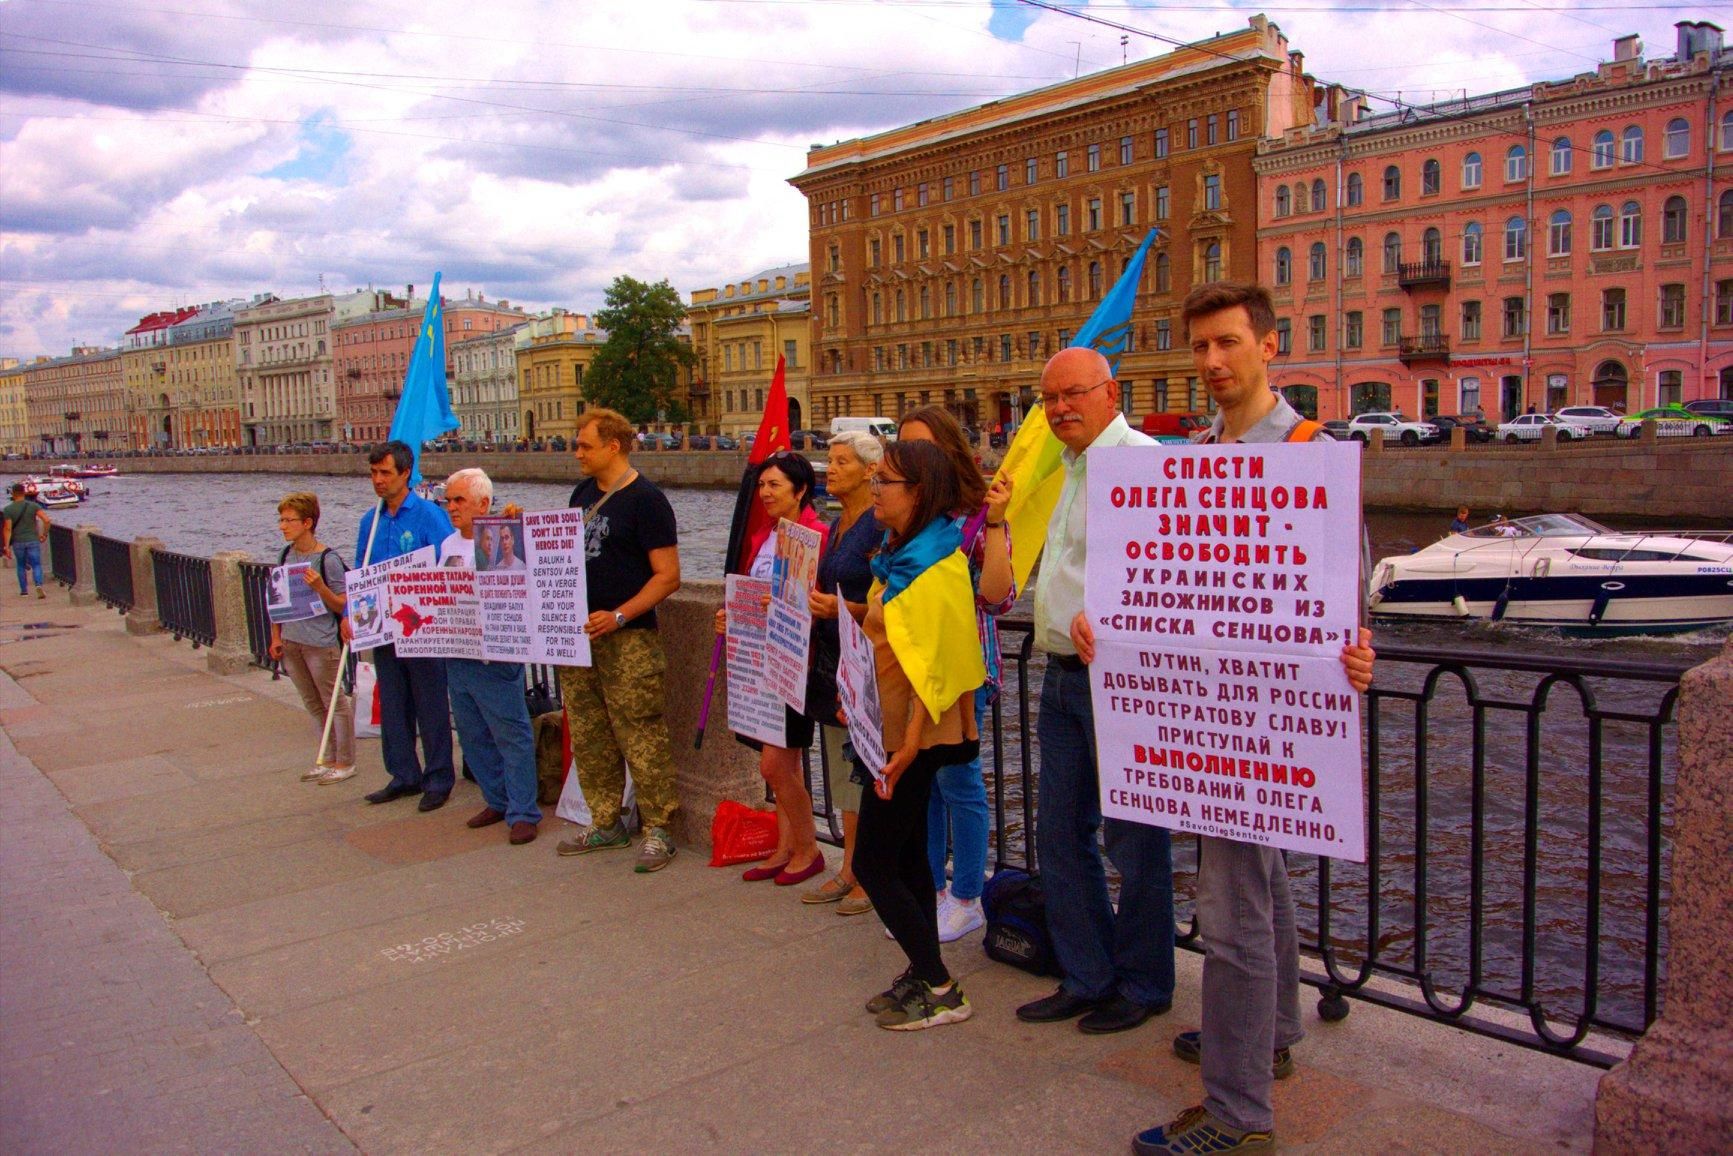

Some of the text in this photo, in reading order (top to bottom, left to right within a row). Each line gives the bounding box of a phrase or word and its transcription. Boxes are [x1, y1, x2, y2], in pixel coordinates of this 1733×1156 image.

[1163, 456, 1264, 480] СПАСТИ
[1110, 486, 1328, 511] ОЛЕГА СЕНЦОВА
[526, 516, 540, 526] SAVE
[542, 514, 560, 525] YOUR
[561, 512, 581, 523] SOUL!
[1158, 513, 1270, 538] ЗНАЧИТ
[531, 526, 577, 538] DON'T LET THE
[535, 539, 574, 551] HEROES DIE!
[538, 556, 565, 565] BALUKH
[1125, 541, 1307, 566] ОСВОБОДИТЬ
[360, 568, 370, 578] ЗА
[373, 562, 391, 574] ЭТОТ
[393, 554, 414, 567] ФЛАГ
[533, 567, 578, 577] SENTSOV ARE
[390, 571, 475, 583] КРЫМСКИЕ ТАТАРЫ
[536, 579, 577, 588] ON A VERGE
[1126, 567, 1308, 592] УКРАИНСКИХ
[394, 581, 474, 595] КОРЕННОЙ НАРОД
[541, 590, 573, 599] OF DEATH
[419, 596, 457, 606] КРЫМА!
[541, 601, 575, 610] AND YOUR
[1120, 589, 1325, 618] ЗАЛОЖНИКОВ ИЗ
[437, 608, 476, 616] ДЕКЛАРАЦИЯ
[541, 613, 576, 622] SILENCE IS
[432, 617, 448, 625] ООН
[455, 617, 476, 625] ПРАВАХ
[1099, 613, 1195, 636] «СПИСКА
[422, 626, 483, 636] КОРЕННЫХ НАРОДОВ
[537, 624, 582, 635] RESPONSIBLE
[397, 637, 445, 645] ГАРАНТИРУЕТ
[545, 636, 575, 646] FOR THIS
[545, 648, 576, 658] AS WELL!
[1139, 651, 1300, 681] ПУТИН, ХВАТИТ
[1103, 671, 1353, 713] ДОБЫВАТЬ ДЛЯ РОССИИ
[1110, 695, 1347, 739] ГЕРОСТРАТОВУ СЛАВУ!
[1157, 725, 1295, 759] ПРИСТУПАЙ К
[1133, 744, 1316, 788] ВЫПОЛНЕНИЮ
[1123, 767, 1324, 815] ТРЕБОВАНИЙ ОЛЕГА
[1110, 788, 1344, 844] СЕНЦОВА НЕМЕДЛЕННО.
[1179, 820, 1271, 842] #SaveOlegSentsov
